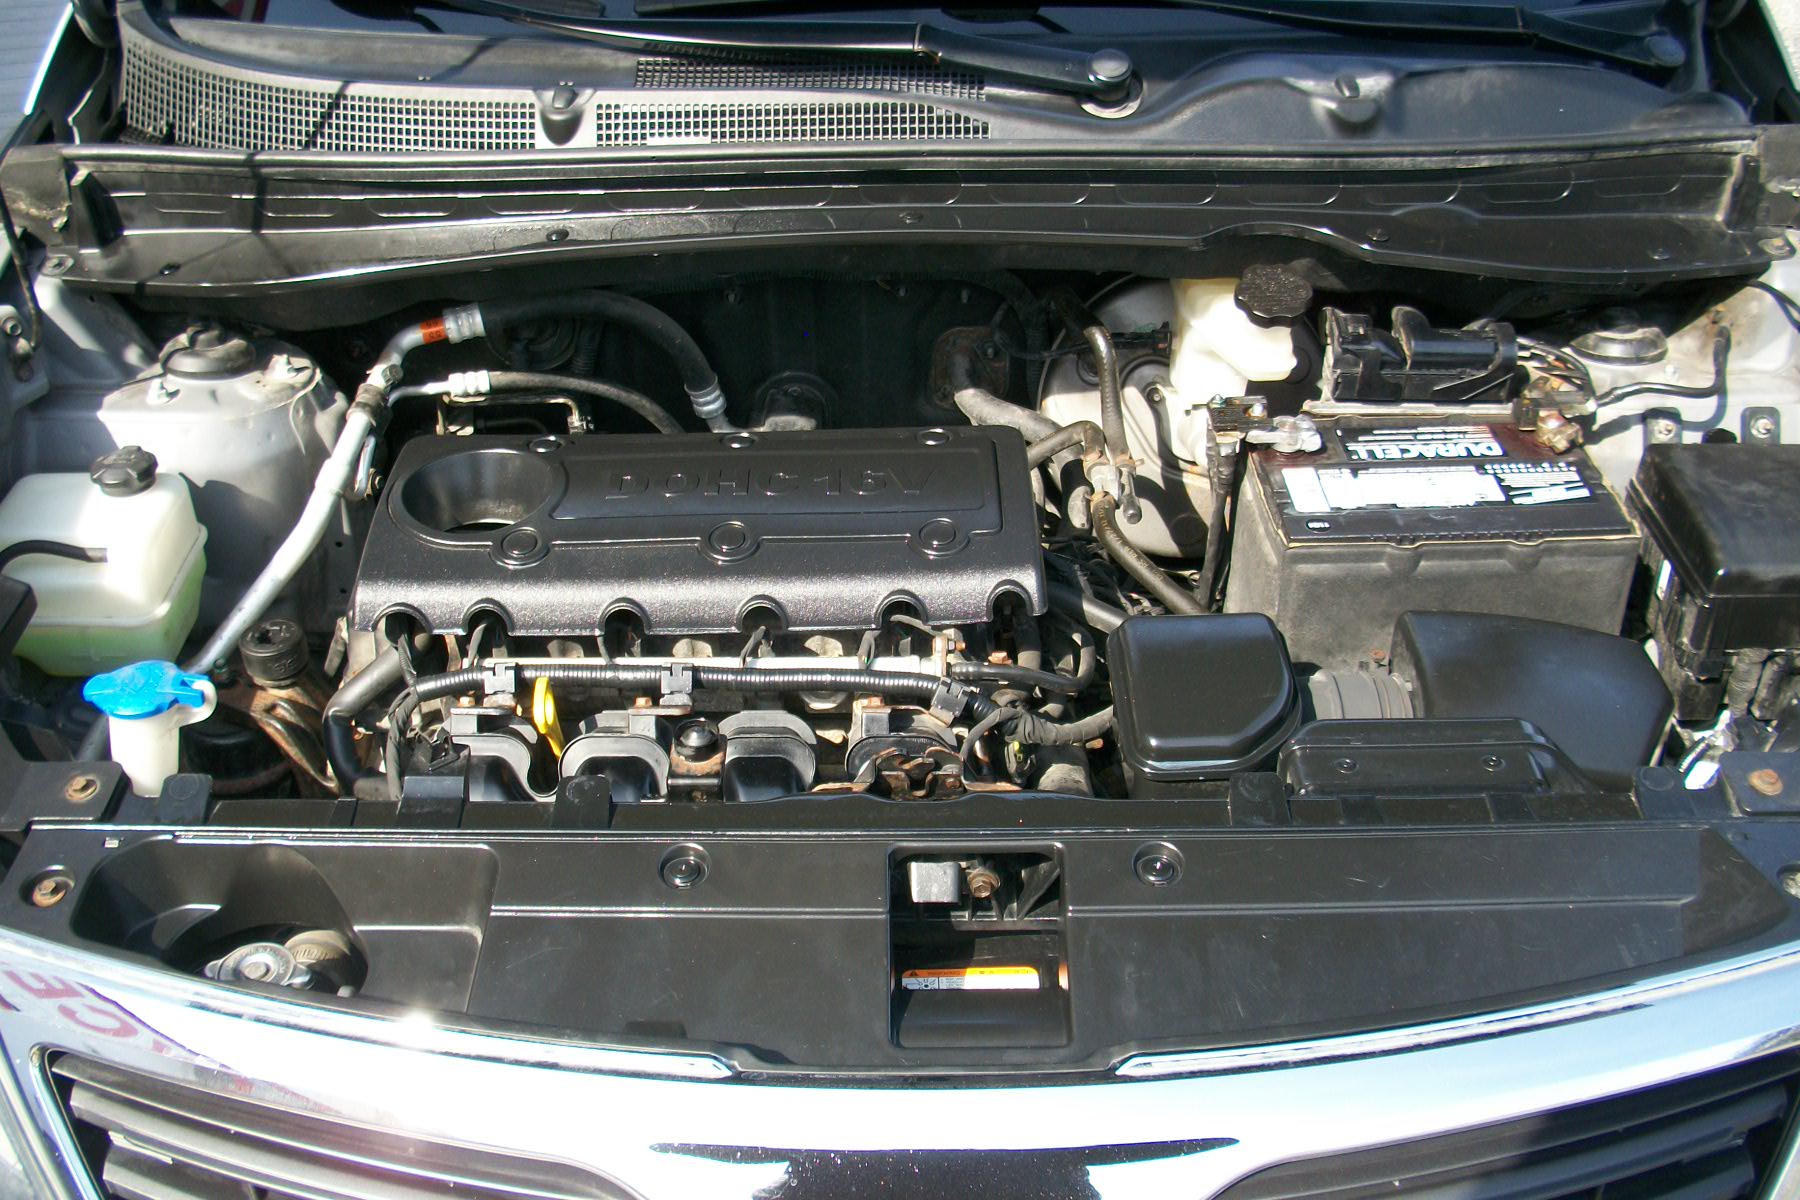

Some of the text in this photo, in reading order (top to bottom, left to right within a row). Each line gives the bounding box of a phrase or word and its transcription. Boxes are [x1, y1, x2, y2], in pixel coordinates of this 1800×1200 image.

[1347, 443, 1504, 460] DURACELL
[605, 466, 935, 499] DOHC 16V
